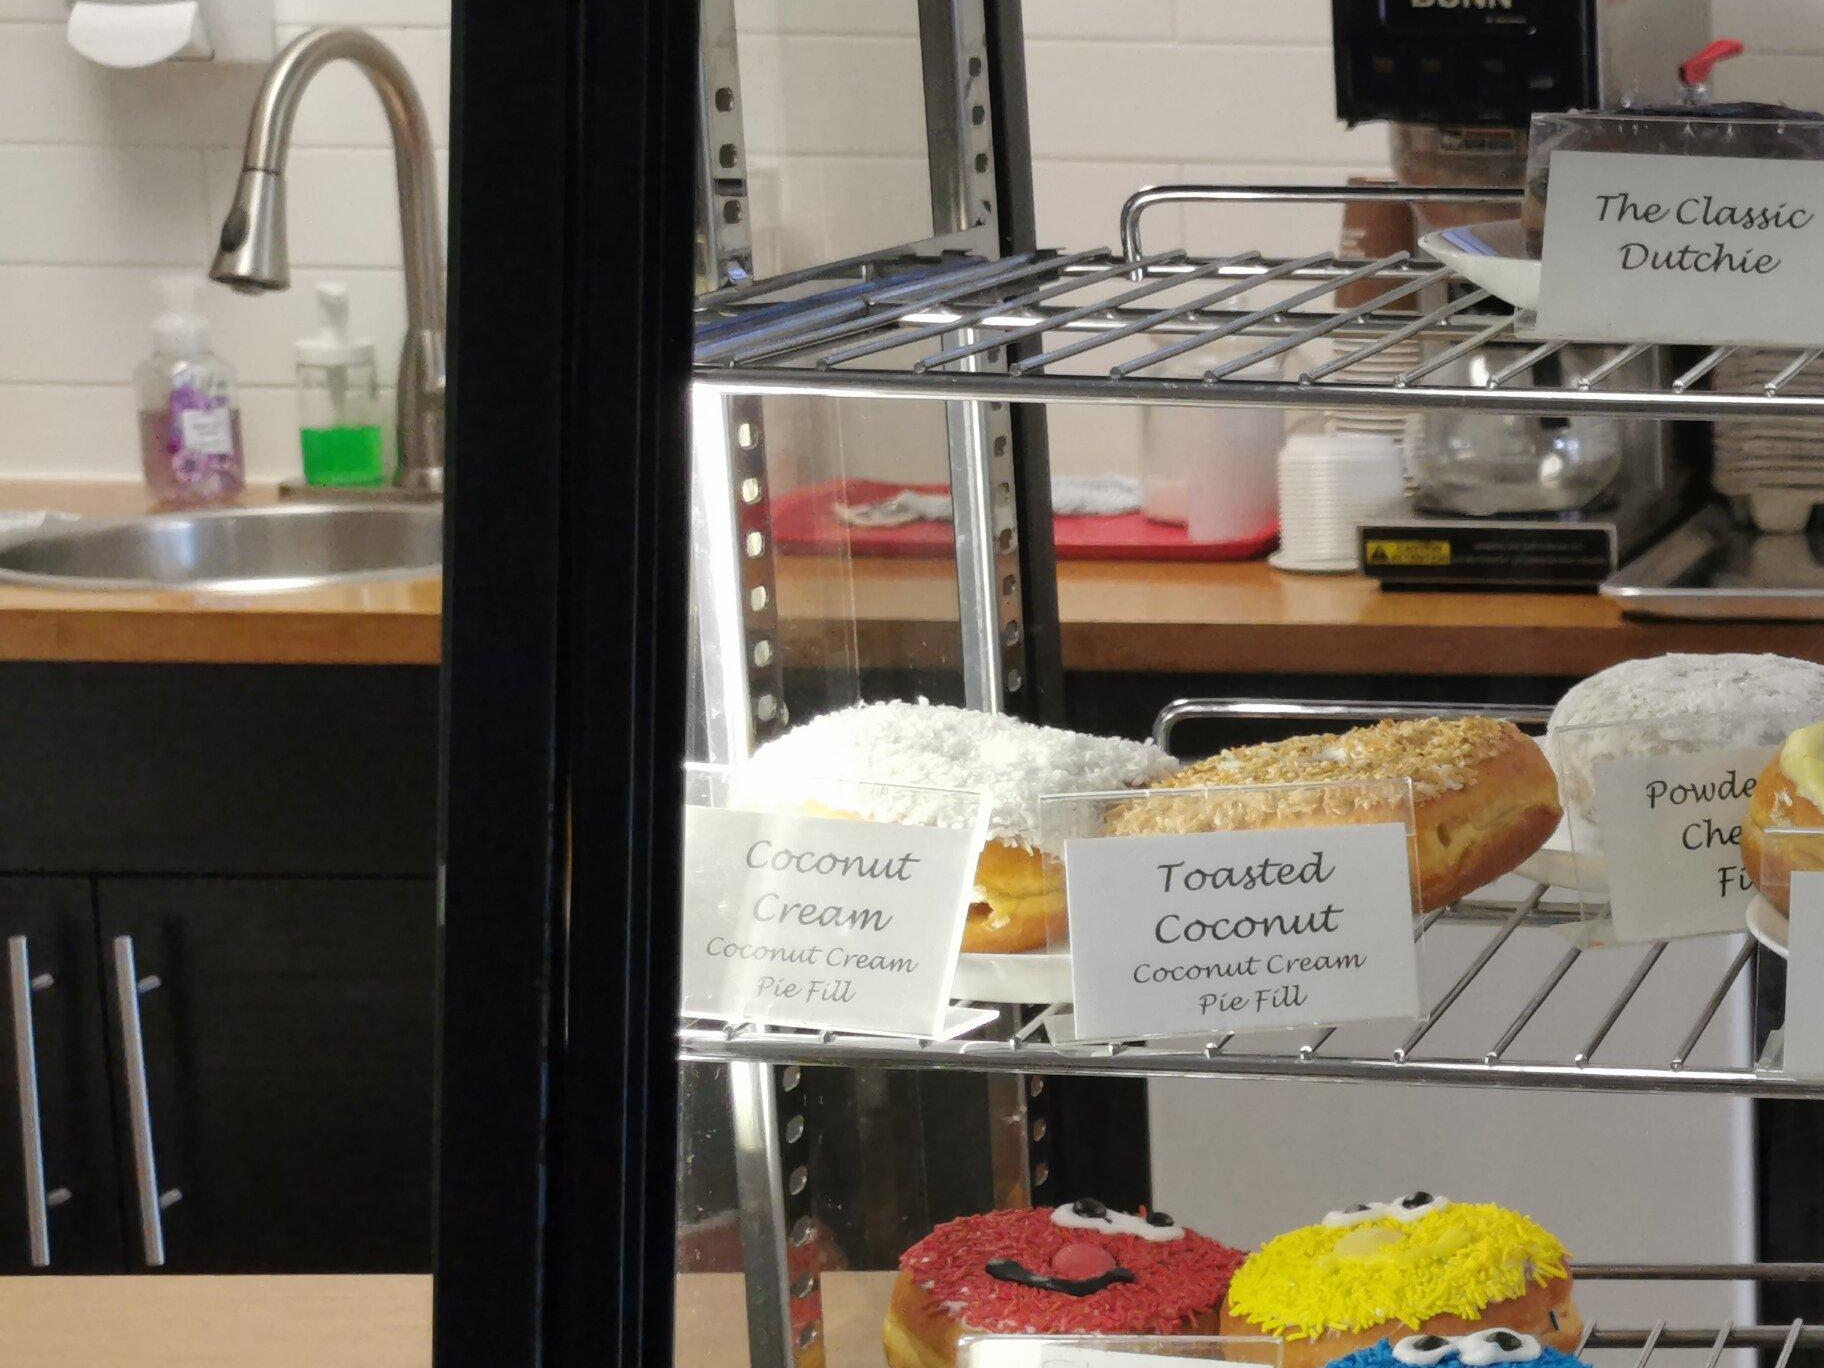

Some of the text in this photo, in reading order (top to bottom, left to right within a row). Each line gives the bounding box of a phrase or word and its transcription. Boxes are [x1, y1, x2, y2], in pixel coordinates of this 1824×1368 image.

[1596, 193, 1814, 230] The Classic
[1619, 242, 1781, 274] Dutchie
[746, 840, 921, 881] Coconut
[1157, 851, 1336, 893] Toasted
[753, 893, 893, 931] Cream
[1155, 903, 1345, 944] Coconut
[706, 937, 919, 973] Coconut Cream
[1133, 951, 1367, 984] Coconut Cream
[757, 976, 857, 1004] Pie Fill
[1199, 984, 1308, 1016] Pie Fill
